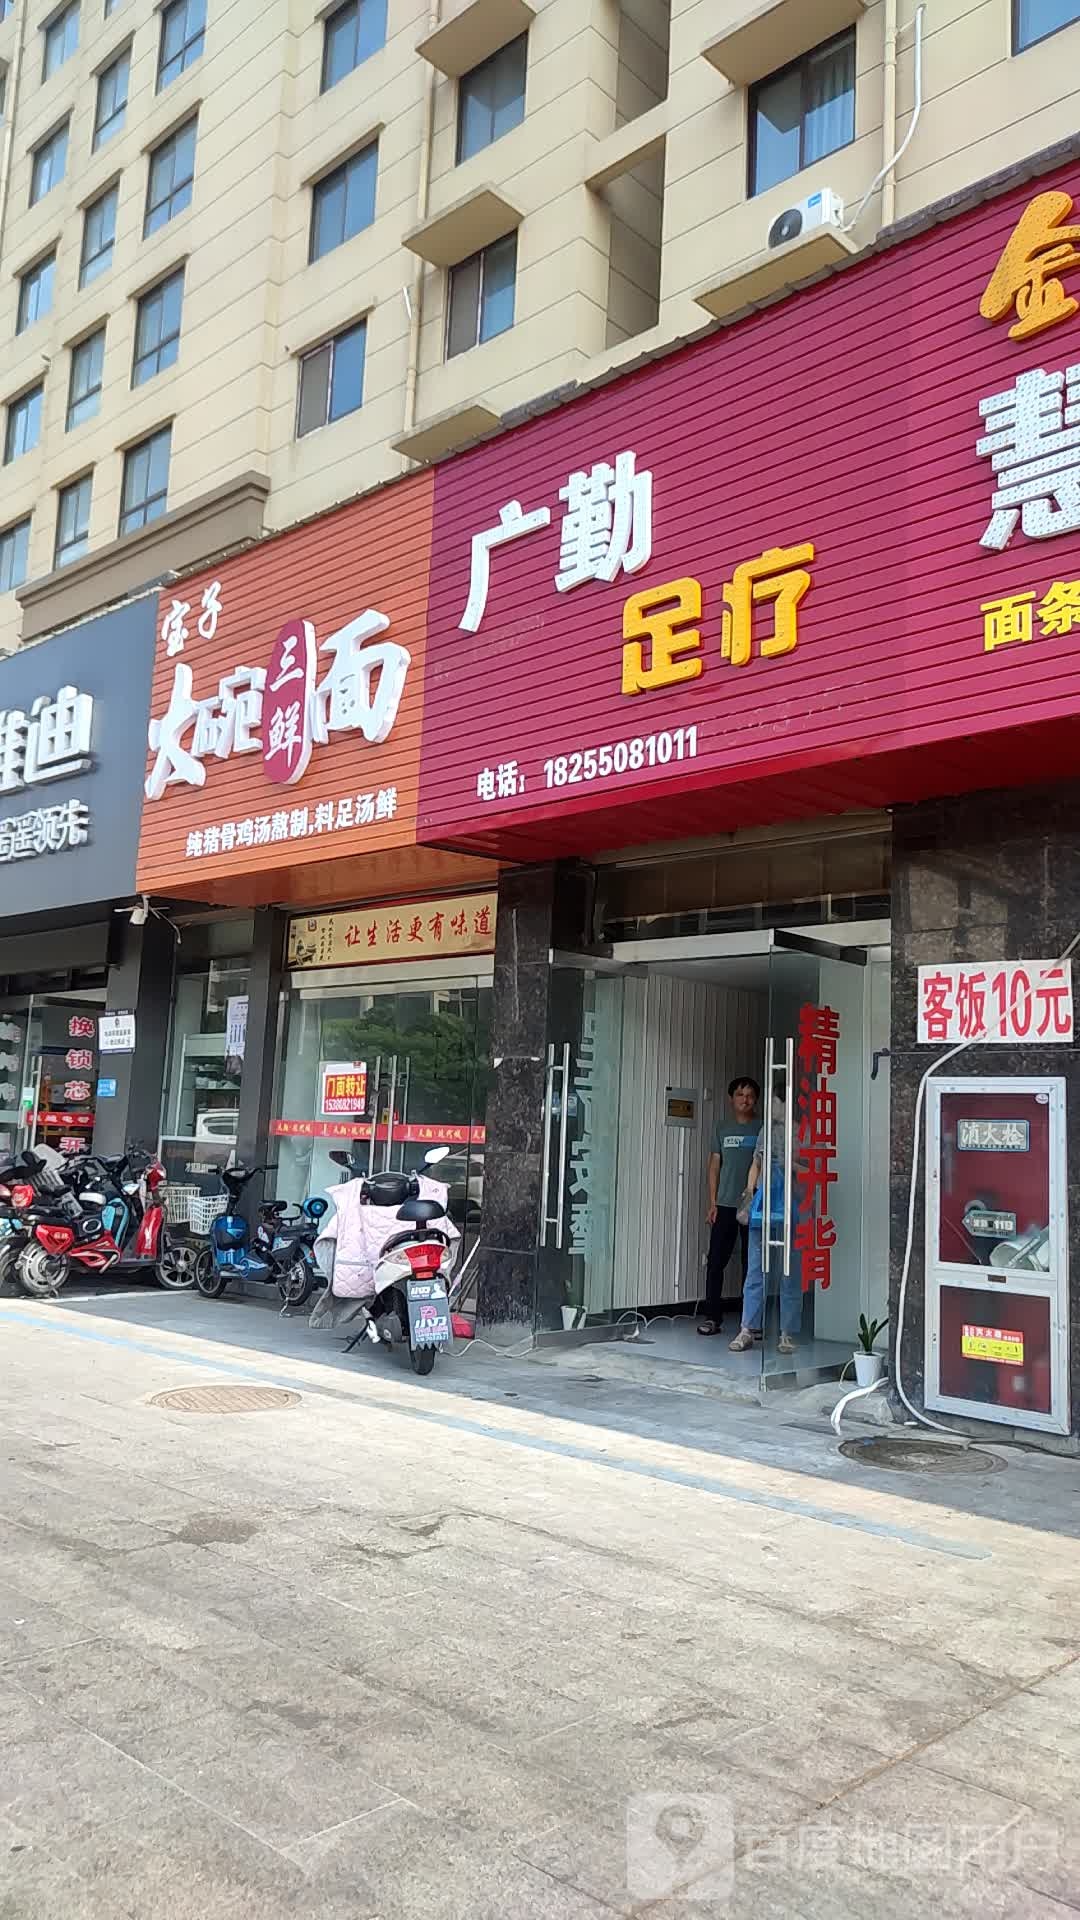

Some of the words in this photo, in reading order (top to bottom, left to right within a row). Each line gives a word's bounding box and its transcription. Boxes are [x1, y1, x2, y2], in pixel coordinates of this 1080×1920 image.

[979, 190, 1080, 341] 金
[458, 450, 653, 632] 广勤
[621, 542, 815, 695] 足疗
[980, 578, 1080, 652] 面条
[313, 608, 413, 744] 面
[543, 725, 698, 788] 18255081011
[344, 904, 493, 947] 让生活更有味道
[921, 968, 1073, 1041] 客饭10元
[326, 1074, 366, 1098] 门面转让
[792, 1002, 841, 1292] 精油开背
[960, 1121, 1025, 1146] 消火栓
